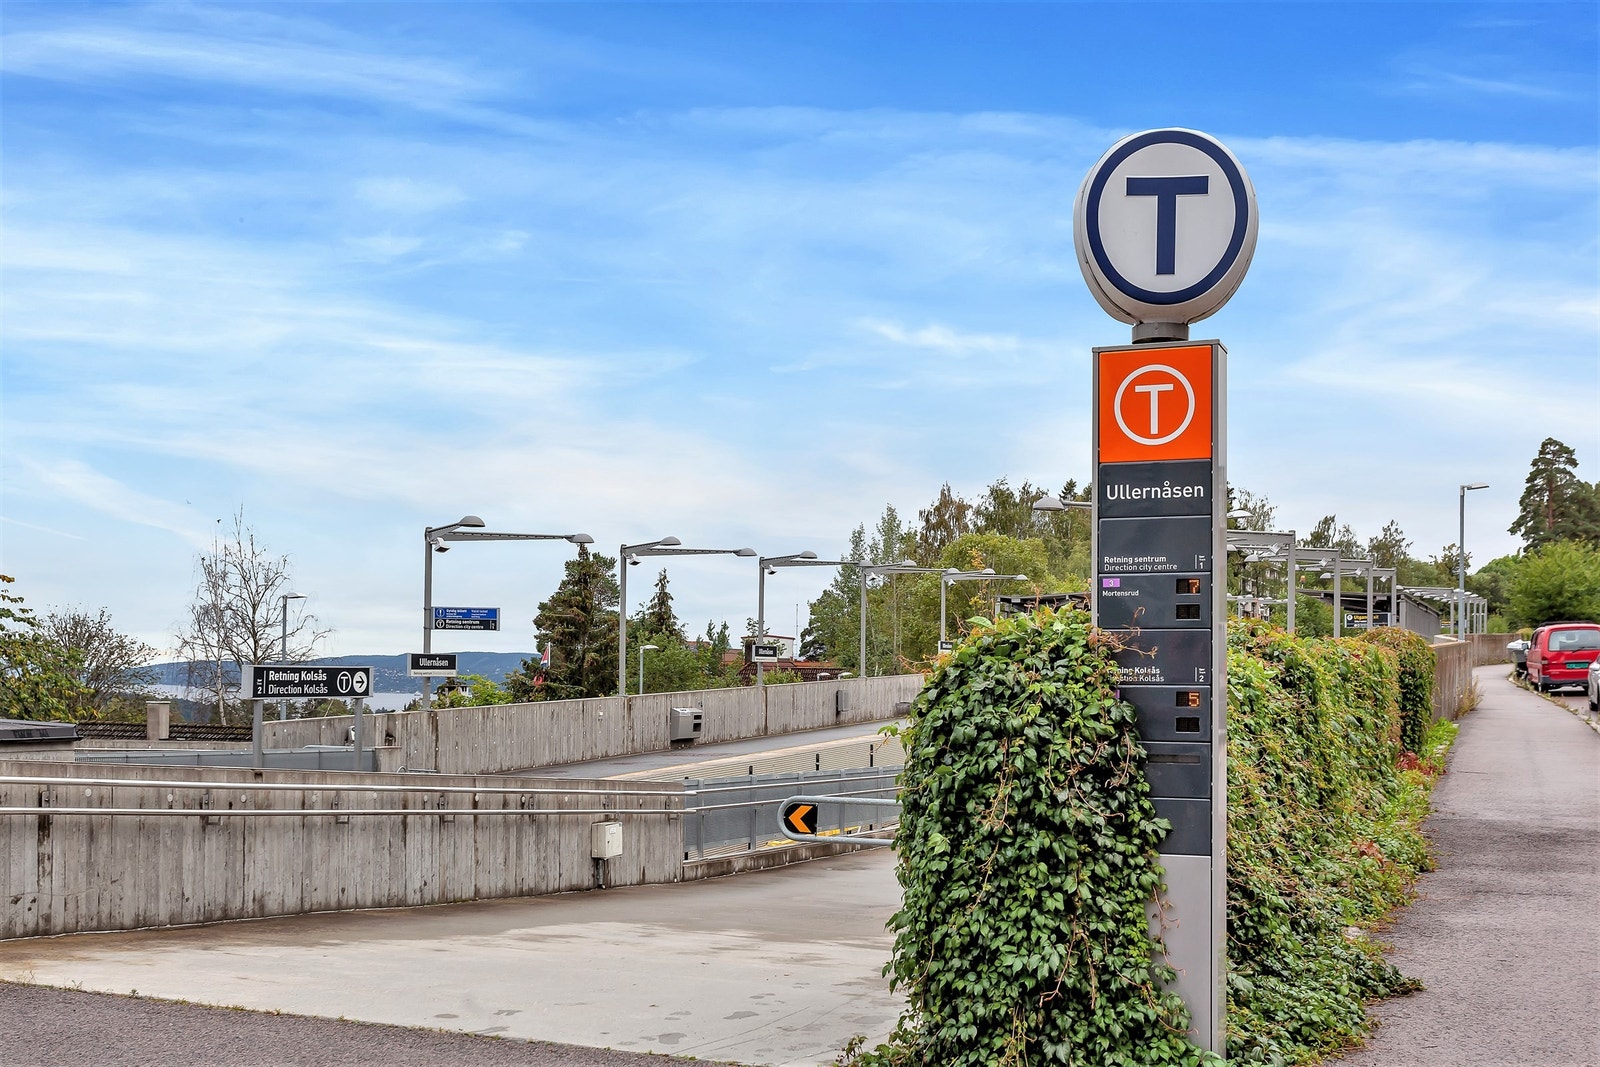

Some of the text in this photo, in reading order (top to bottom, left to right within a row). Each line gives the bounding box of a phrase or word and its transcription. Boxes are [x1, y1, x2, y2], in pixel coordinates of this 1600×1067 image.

[1126, 176, 1209, 275] T
[1134, 383, 1174, 435] T
[1106, 481, 1204, 499] Ullernåsen
[1104, 556, 1133, 564] Retning
[1139, 563, 1153, 571] city
[1189, 579, 1200, 594] 7
[419, 657, 449, 667] Ullernåsen
[269, 669, 327, 682] Retning Kolsås
[1139, 674, 1165, 682] Kolsås
[257, 686, 263, 695] 2
[268, 683, 329, 694] Direction Kolsås
[1189, 692, 1200, 707] 5
